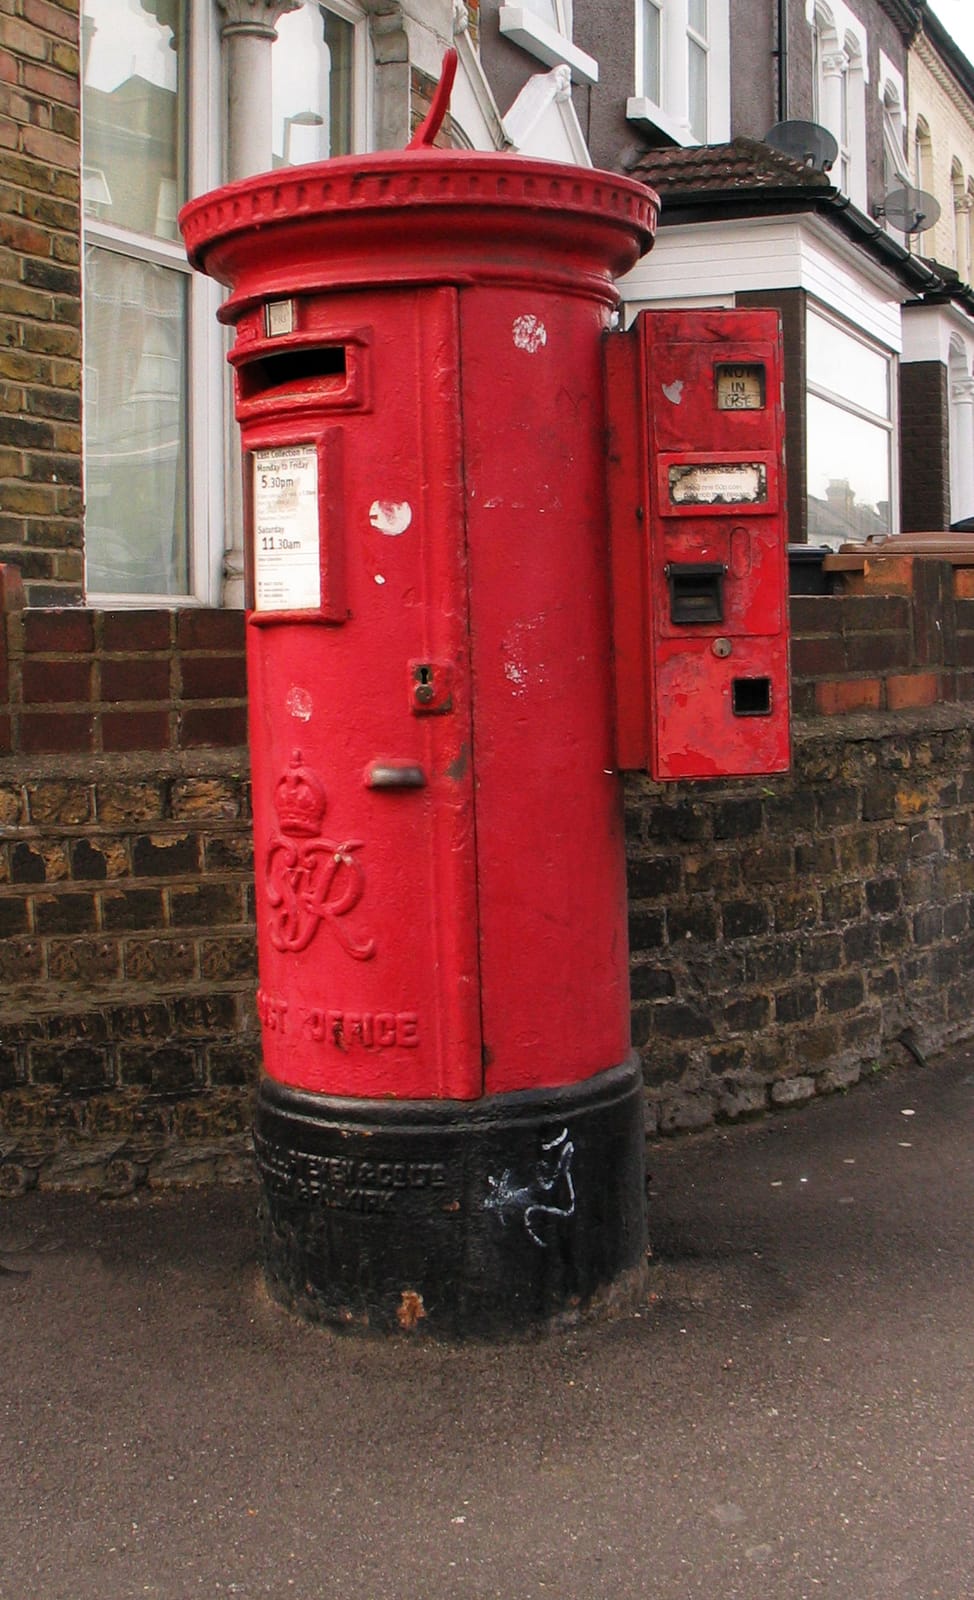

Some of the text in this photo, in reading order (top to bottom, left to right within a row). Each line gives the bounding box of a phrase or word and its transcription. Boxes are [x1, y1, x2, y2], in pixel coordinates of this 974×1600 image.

[731, 382, 745, 393] IN
[271, 448, 300, 458] Collection
[257, 460, 309, 472] Monday to Friday
[261, 475, 294, 489] 5.30pm
[258, 526, 285, 535] Saturday
[304, 1007, 420, 1047] OFFICE
